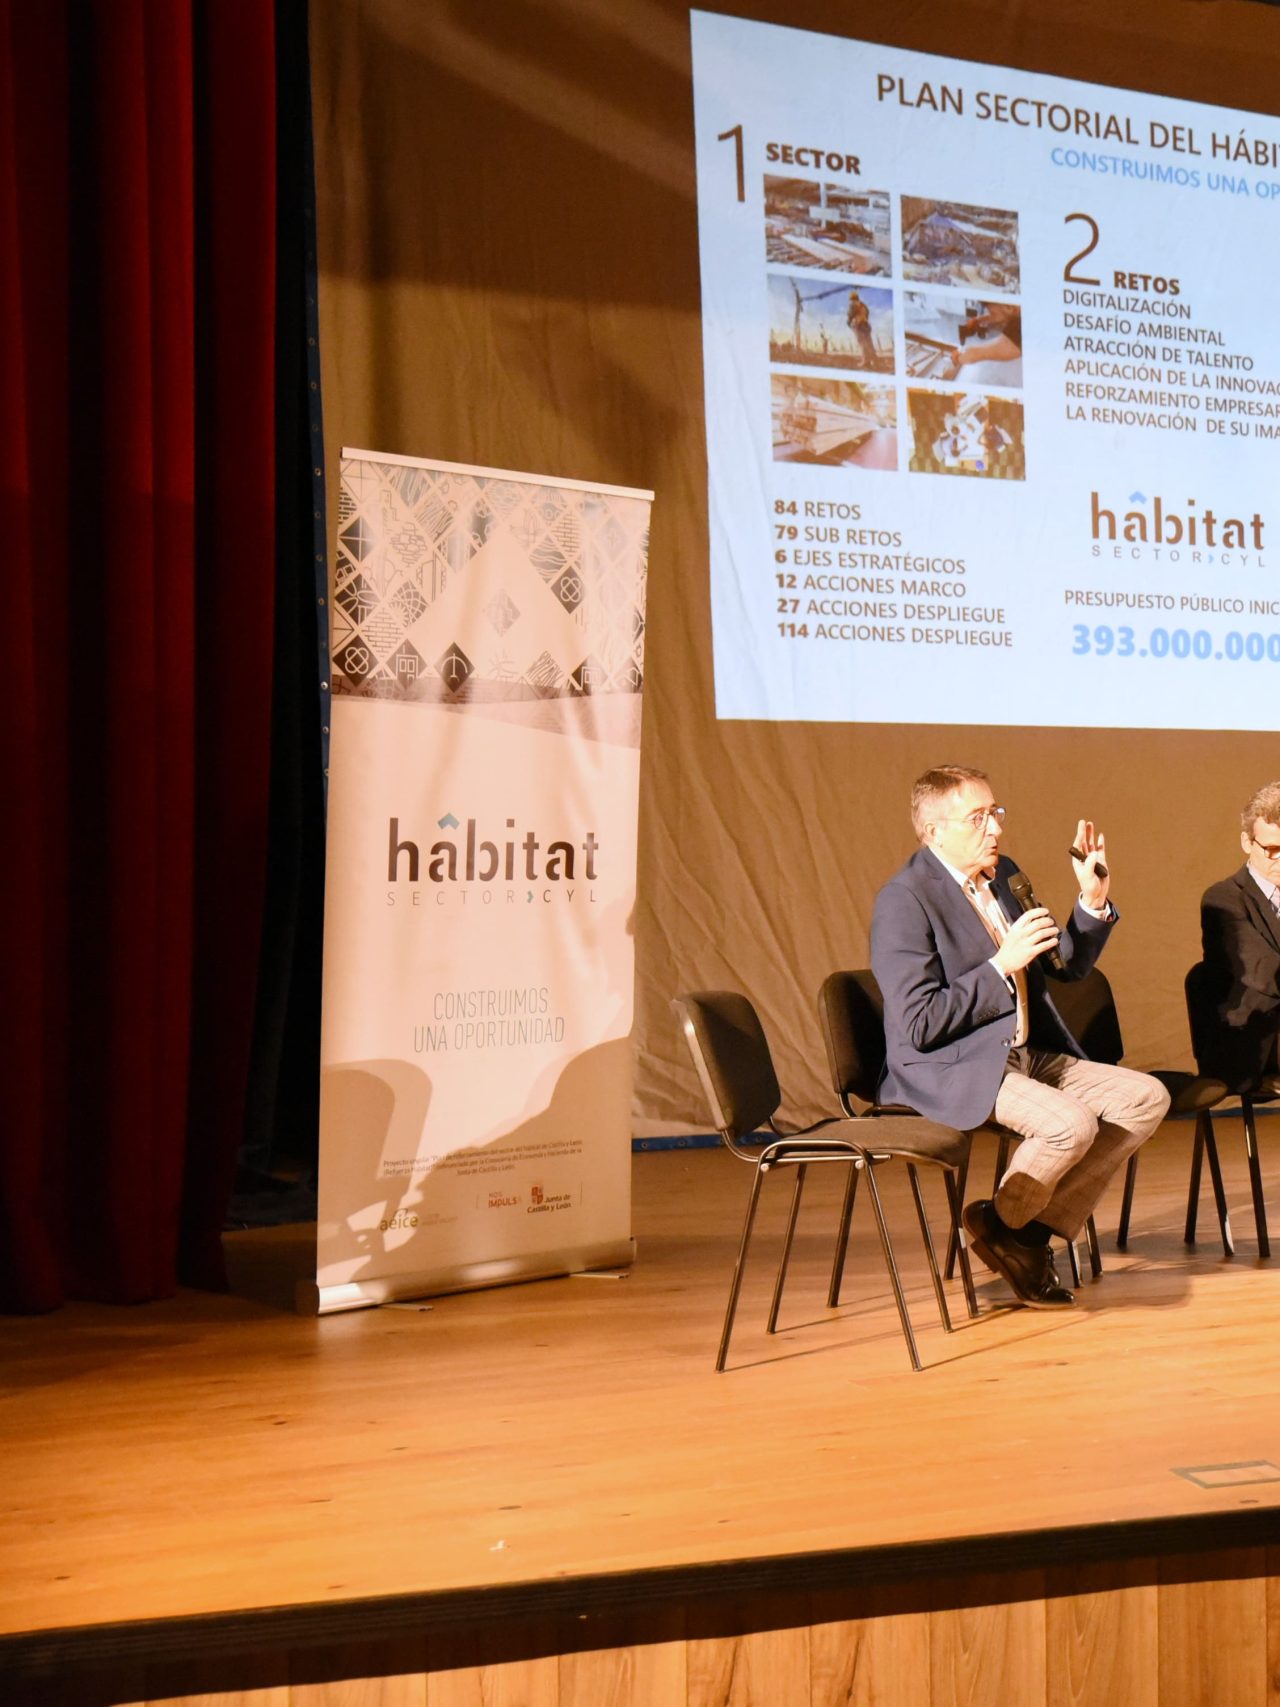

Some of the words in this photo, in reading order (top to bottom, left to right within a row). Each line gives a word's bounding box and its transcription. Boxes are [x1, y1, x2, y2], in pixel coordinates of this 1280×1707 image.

[877, 74, 963, 115] PLAN
[976, 91, 1139, 145] SECTORIAL
[1150, 122, 1201, 156] DEL
[717, 124, 746, 203] 1
[766, 142, 861, 175] SECTOR
[1051, 147, 1201, 188] CONSTRUIMOS
[1207, 173, 1250, 196] UNA
[1063, 213, 1100, 286] 2
[1114, 271, 1180, 295] RETOS
[1063, 289, 1191, 319] DIGITALIZACIÓN
[1064, 313, 1132, 335] DESAFÍO
[1137, 323, 1226, 346] AMBIENTAL
[1064, 336, 1156, 360] ATRACCIÓN
[1162, 347, 1181, 363] DE
[1186, 350, 1254, 371] TALENTO
[1065, 359, 1161, 383] APLICACIÓN
[1167, 370, 1186, 386] DE
[1192, 373, 1211, 388] LA
[1065, 382, 1200, 410] REFORZAMIENTO
[1066, 405, 1086, 421] LA
[1092, 407, 1197, 432] RENOVACIÓN
[1206, 419, 1226, 435] DE
[1230, 422, 1250, 437] SU
[774, 500, 798, 517] 84
[804, 502, 861, 521] RETOS
[775, 524, 799, 541] 79
[804, 526, 840, 544] SUB
[847, 528, 902, 548] RETOS
[775, 549, 788, 565] 6
[793, 549, 832, 568] EJES
[838, 551, 966, 575] ESTRATÉGICOS
[775, 573, 798, 590] 12
[803, 574, 895, 595] ACCIONES
[901, 578, 967, 598] MARCO
[776, 598, 800, 615] 27
[806, 599, 897, 619] ACCIONES
[903, 602, 1006, 624] DESPLIEGUE
[1065, 589, 1175, 611] PRESUPUESTO
[1180, 591, 1244, 614] PÚBLICO
[777, 622, 809, 639] 114
[815, 623, 906, 643] ACCIONES
[911, 626, 1013, 648] DESPLIEGUE
[433, 987, 549, 1020] CONSTRUIMOS
[414, 1024, 448, 1053] UNA
[454, 1017, 565, 1050] OPORTUNIDAD
